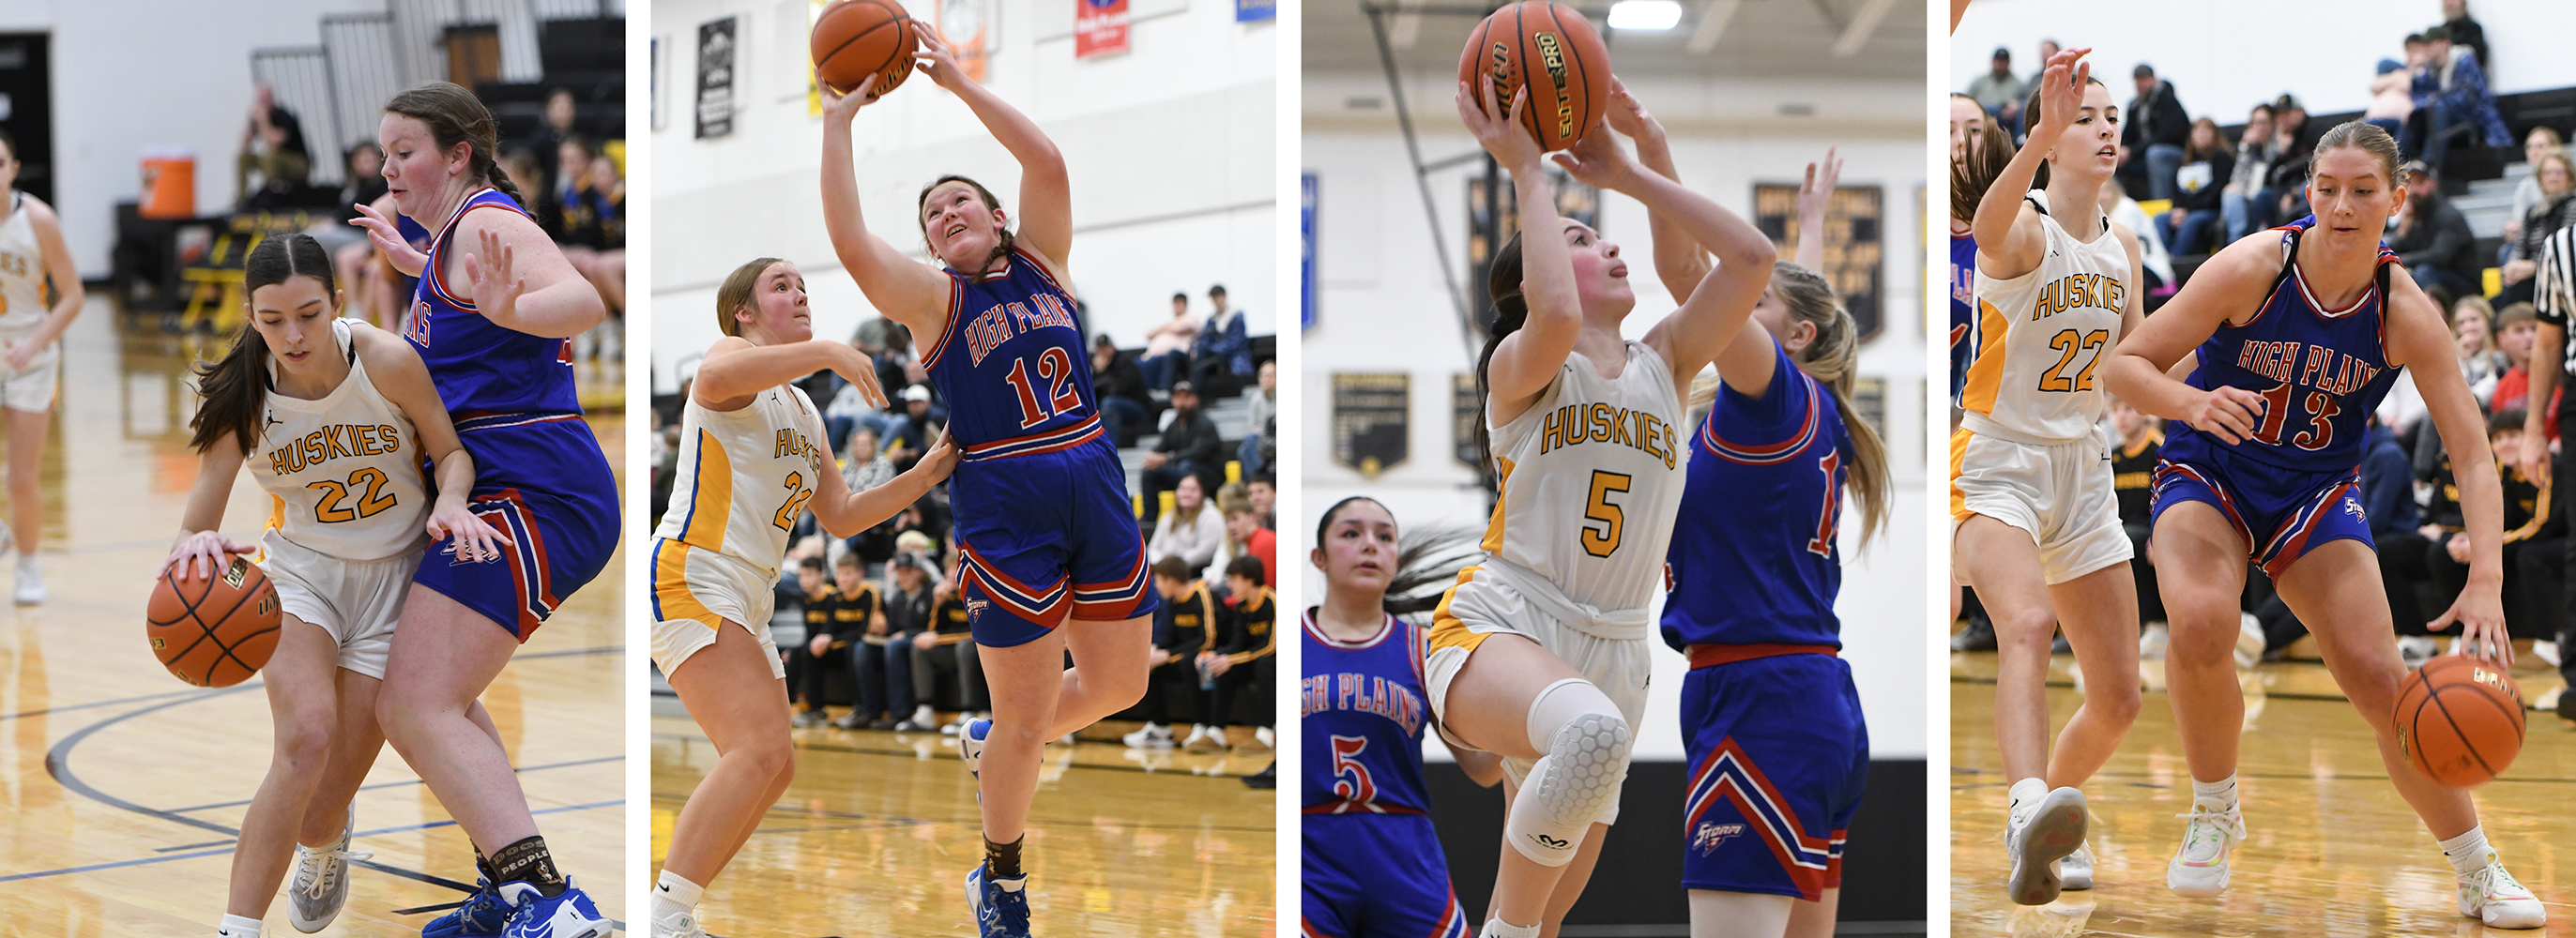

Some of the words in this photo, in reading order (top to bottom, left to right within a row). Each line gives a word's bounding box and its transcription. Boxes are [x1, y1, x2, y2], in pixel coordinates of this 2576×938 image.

[2032, 273, 2125, 321] HUSKIE
[964, 303, 1014, 369] HIGH
[2037, 328, 2110, 393] 22
[2236, 339, 2301, 384] HIGH
[2299, 343, 2383, 396] PLAIN
[1005, 346, 1082, 430] 12
[2251, 382, 2341, 452] 13
[268, 424, 400, 476] HUSKIES
[1540, 402, 1677, 471] HUSKIES
[306, 466, 398, 523] 22
[1580, 468, 1632, 559] 5
[1302, 673, 1330, 719] GH
[1337, 673, 1422, 738] PLAINS
[1331, 734, 1378, 804] 5
[501, 850, 548, 874] PEOPLE
[1693, 822, 1743, 847] STORM
